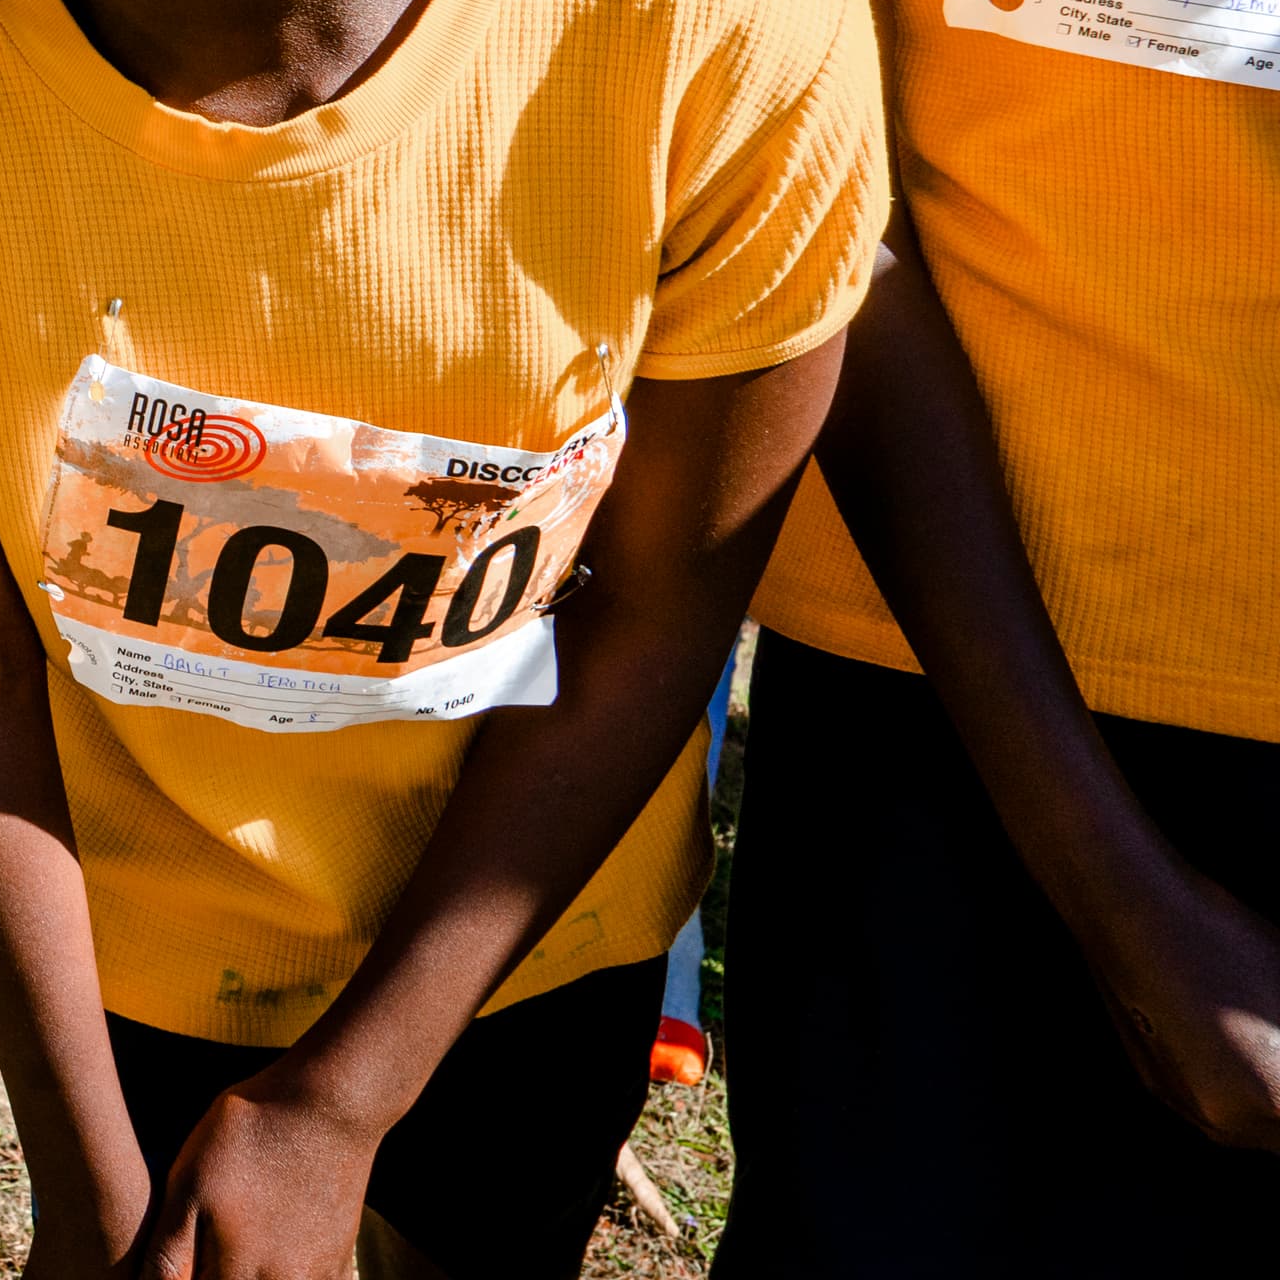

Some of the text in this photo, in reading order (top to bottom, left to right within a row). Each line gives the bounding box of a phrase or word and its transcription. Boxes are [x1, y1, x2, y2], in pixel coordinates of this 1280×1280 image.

[1059, 5, 1133, 29] City, State
[1078, 26, 1200, 58] Male Female
[1245, 55, 1274, 71] Age
[127, 391, 207, 447] ROSA
[123, 433, 199, 464] ASSOCIATI
[446, 431, 597, 483] DISCOERY
[106, 498, 541, 664] 1040
[117, 646, 152, 663] Name
[113, 660, 164, 679] Address
[112, 671, 174, 693] City, State
[128, 687, 231, 713] Male Female
[444, 692, 475, 712] 1040
[268, 713, 294, 725] Age
